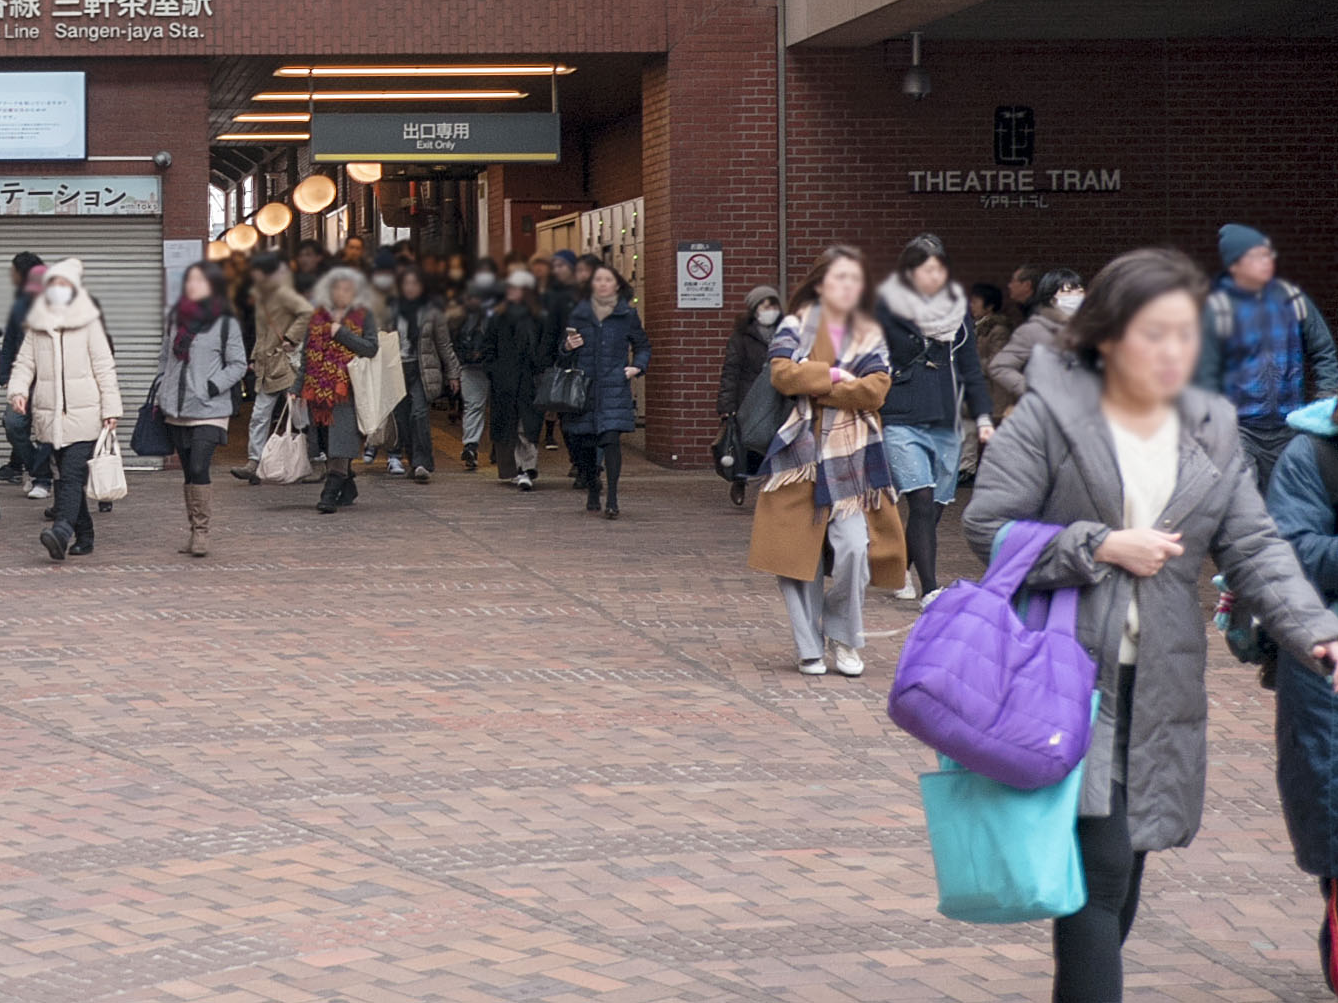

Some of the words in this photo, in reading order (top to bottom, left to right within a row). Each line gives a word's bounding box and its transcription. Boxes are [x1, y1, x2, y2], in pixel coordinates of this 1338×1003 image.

[4, 23, 40, 39] Line
[54, 22, 164, 42] Sangen-jaya
[168, 22, 205, 39] Sta.
[403, 122, 469, 140] 出口専用
[416, 140, 434, 149] Exit
[435, 140, 456, 151] Only
[908, 170, 1035, 192] THEATRE
[1045, 169, 1121, 191] TRAM
